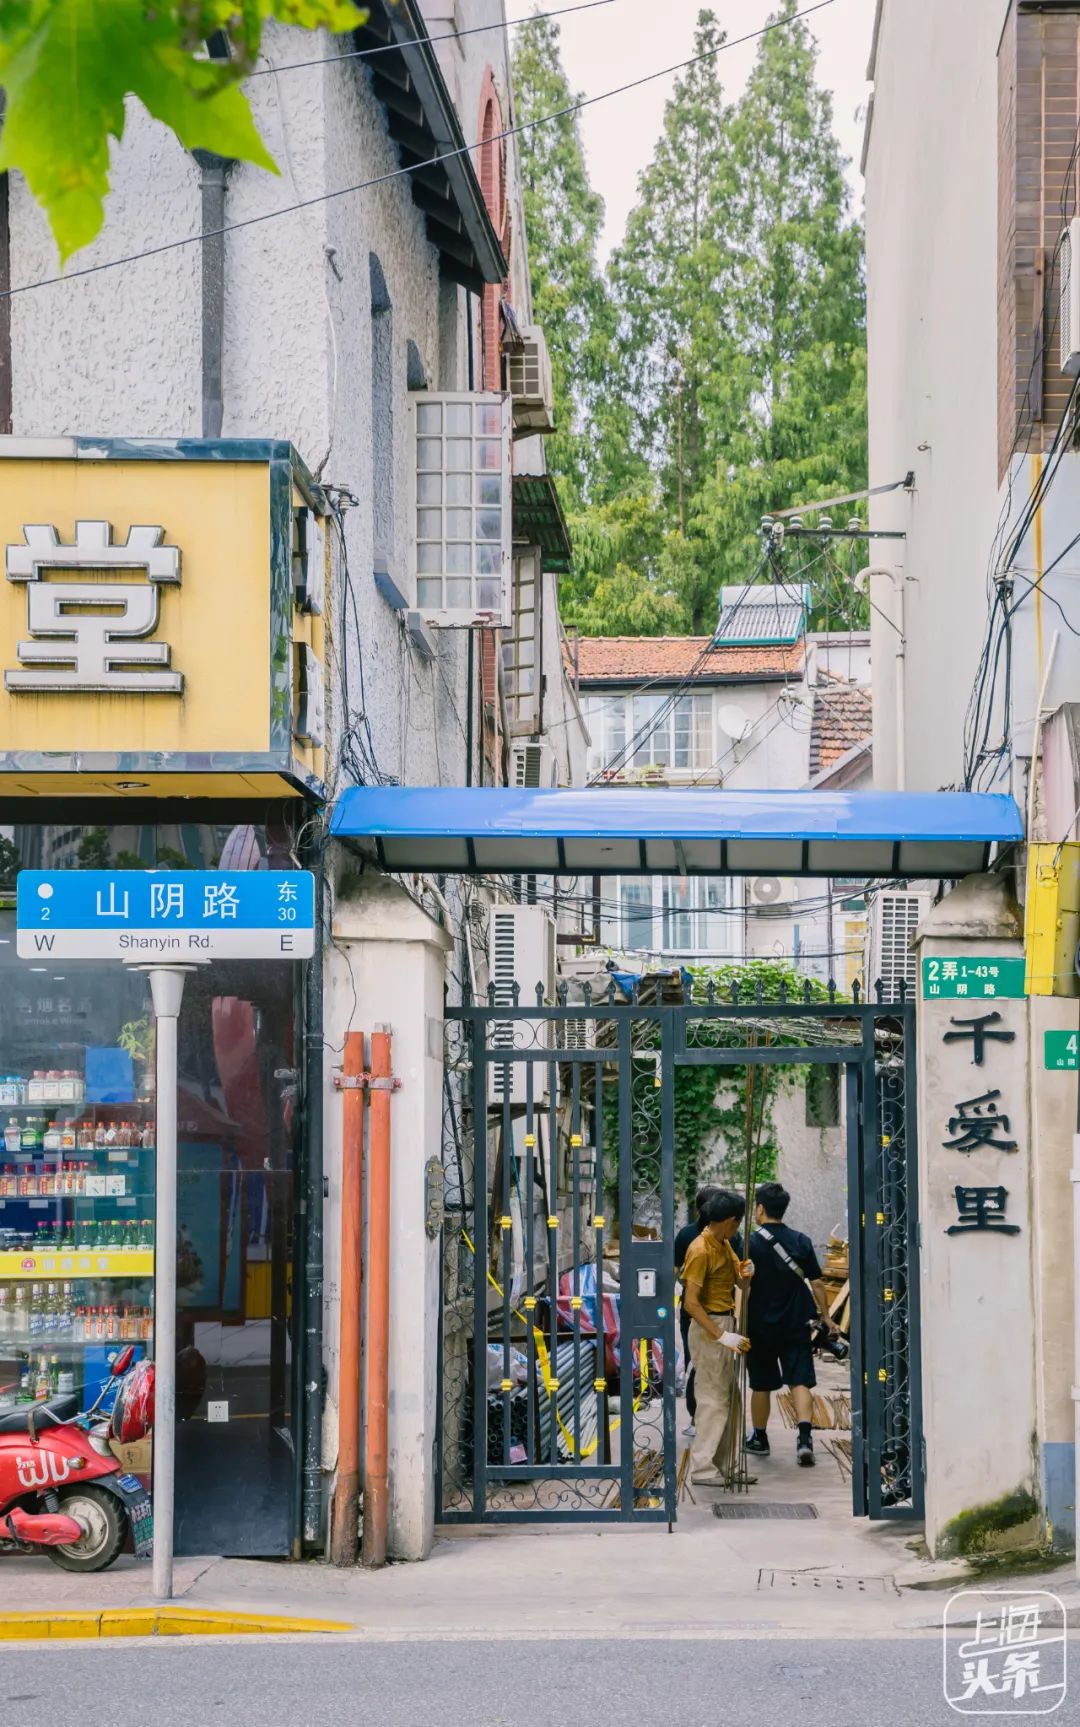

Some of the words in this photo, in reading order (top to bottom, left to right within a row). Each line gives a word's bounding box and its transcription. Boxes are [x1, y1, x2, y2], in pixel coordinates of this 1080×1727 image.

[4, 520, 185, 692] 堂
[96, 881, 241, 920] 山阴路
[277, 880, 299, 903] 东
[40, 908, 51, 921] 2
[277, 908, 297, 921] 30
[34, 934, 55, 952] W
[118, 934, 181, 952] Shanyin
[188, 934, 214, 949] Rd.
[280, 934, 294, 952] E
[942, 1011, 1022, 1236] 千爱里
